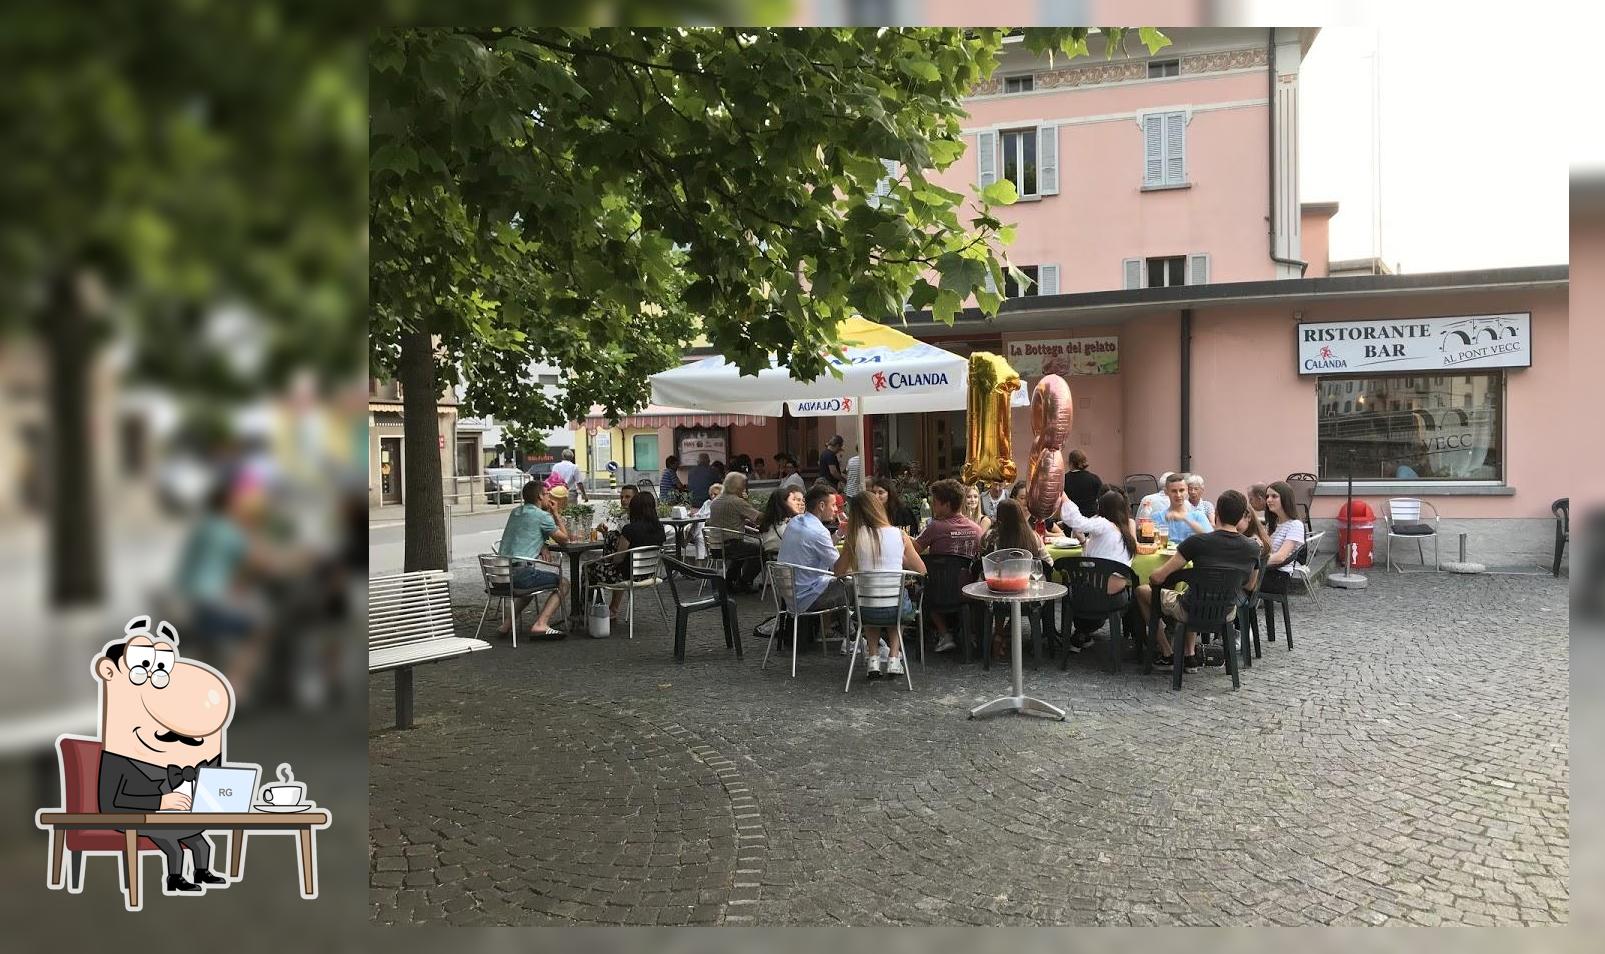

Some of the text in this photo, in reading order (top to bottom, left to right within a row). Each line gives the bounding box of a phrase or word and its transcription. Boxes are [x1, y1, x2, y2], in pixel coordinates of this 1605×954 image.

[1303, 324, 1431, 342] RISTORANTE
[1010, 341, 1116, 358] La Bottega del gelato
[1363, 344, 1406, 358] BAR
[1443, 341, 1521, 365] AL PONT VECC
[1304, 359, 1347, 370] CALANDA
[888, 371, 949, 389] CALANDA
[1422, 433, 1473, 450] VECC
